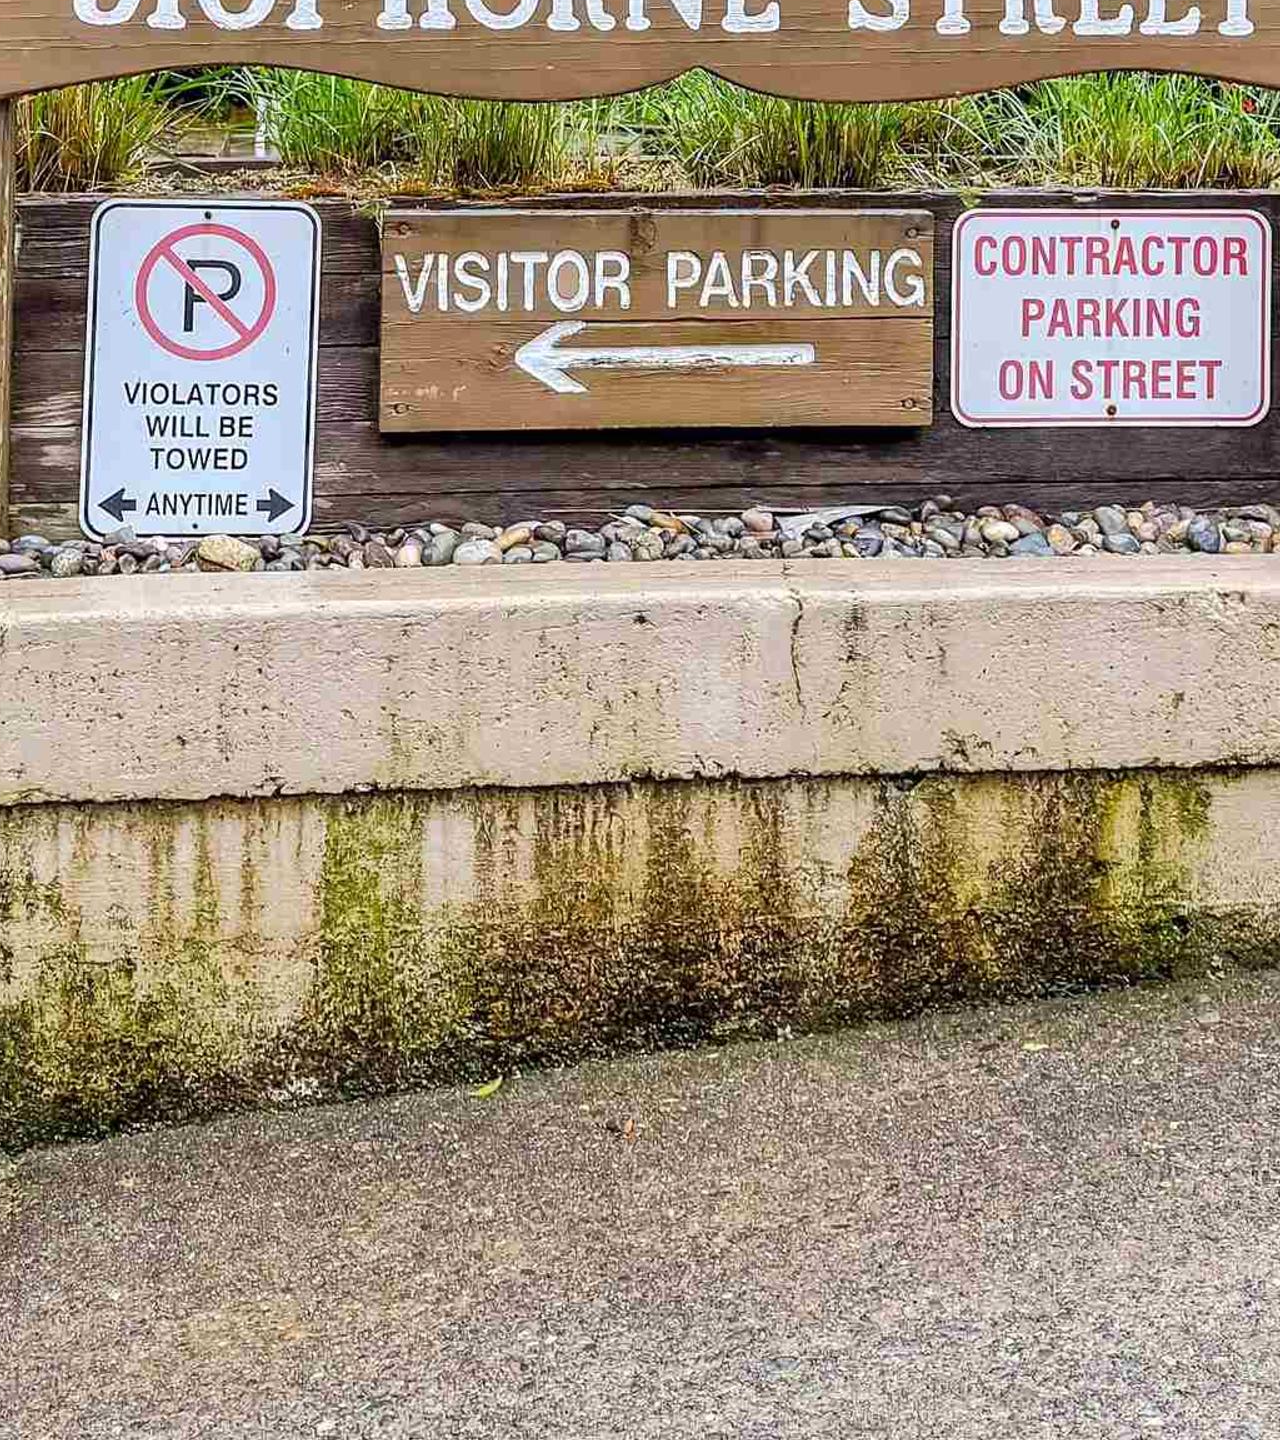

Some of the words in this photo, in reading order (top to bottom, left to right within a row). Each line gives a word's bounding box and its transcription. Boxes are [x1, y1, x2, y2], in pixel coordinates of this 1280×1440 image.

[973, 234, 1249, 277] CONTRACTOR
[182, 259, 242, 333] P
[393, 250, 632, 313] VISITOR
[665, 248, 926, 309] PARKING
[1021, 297, 1202, 338] PARKING
[123, 381, 279, 407] VIOLATORS
[998, 360, 1055, 401] ON
[1069, 359, 1224, 401] STREET
[145, 415, 210, 438] WILL
[219, 415, 254, 438] BE
[150, 447, 249, 471] TOWED
[145, 492, 249, 517] ANYTIME
